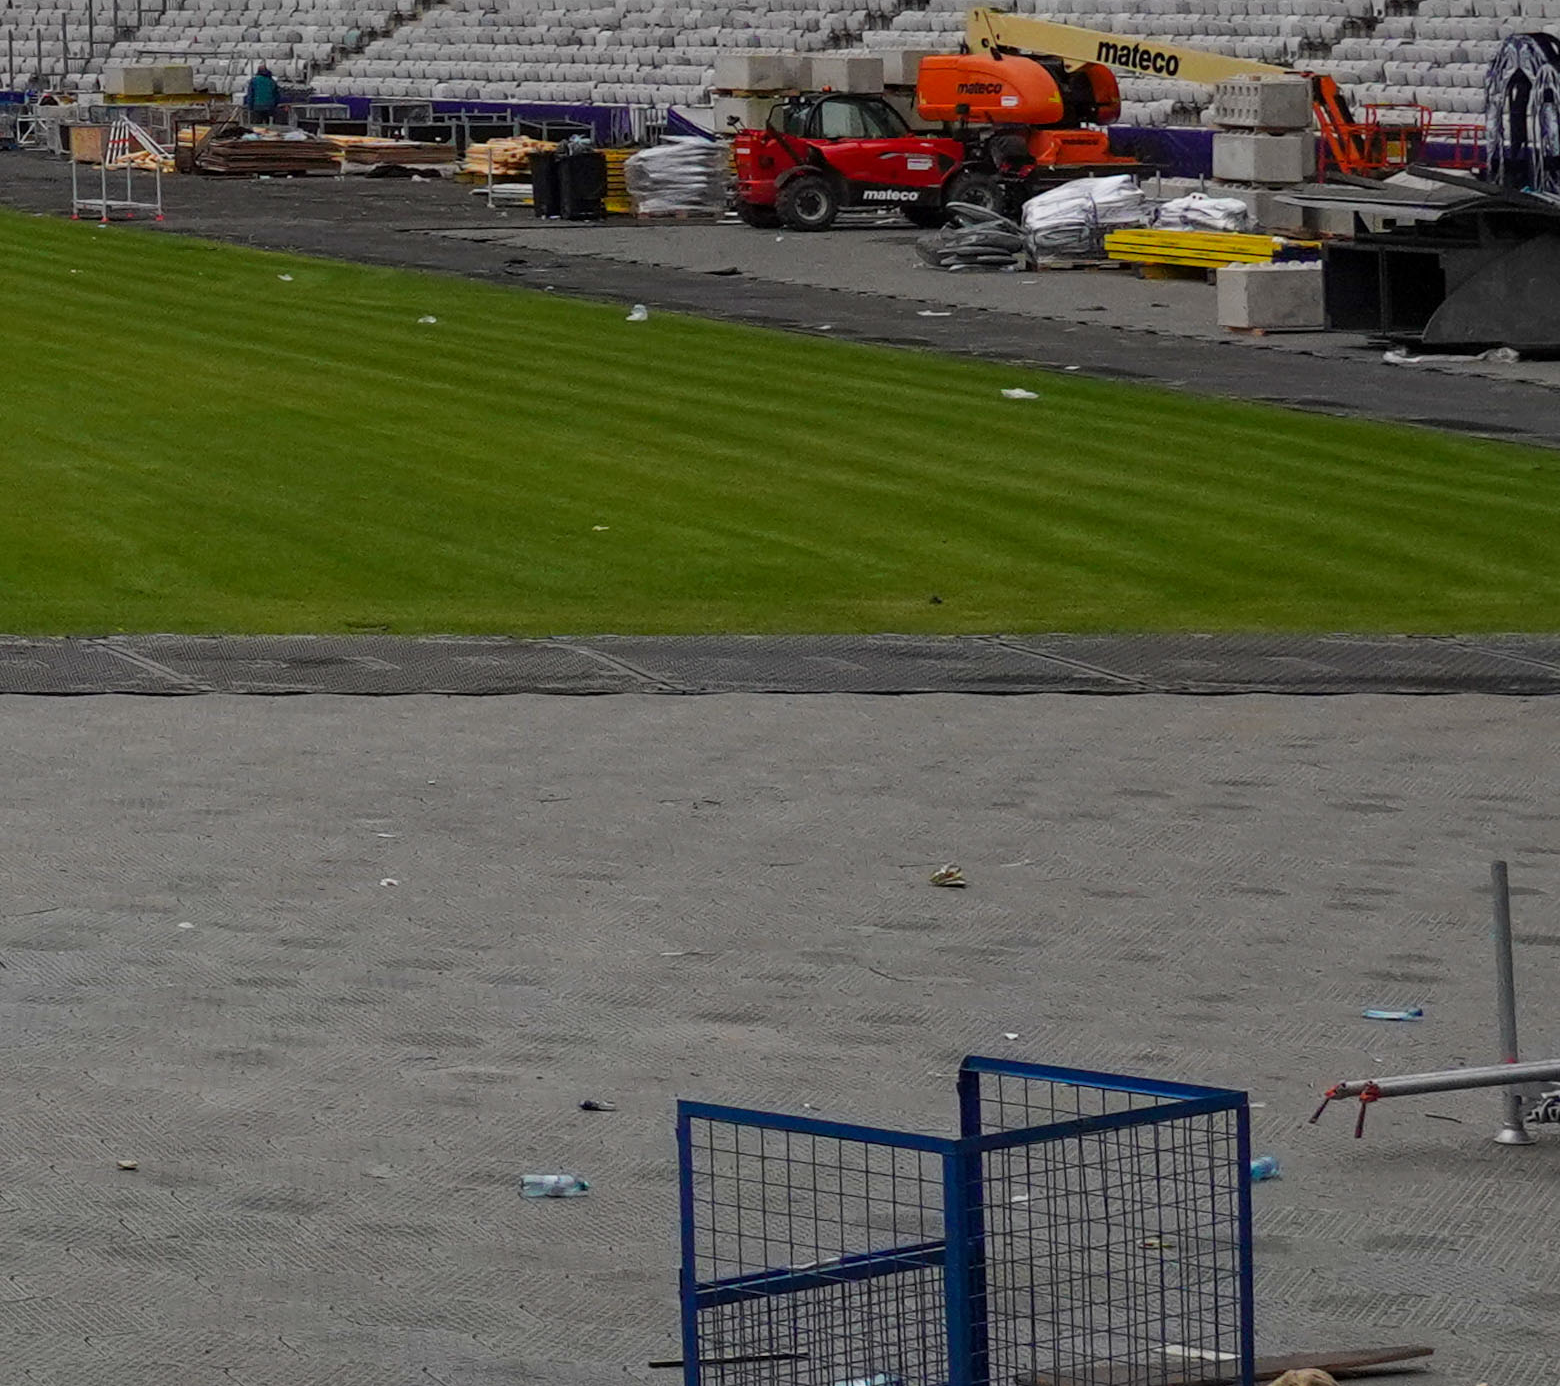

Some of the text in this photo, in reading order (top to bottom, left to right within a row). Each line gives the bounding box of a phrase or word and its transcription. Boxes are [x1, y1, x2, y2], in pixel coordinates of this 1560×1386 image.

[1097, 42, 1179, 76] mateco
[957, 82, 1002, 94] mateco
[863, 189, 918, 201] mateco
